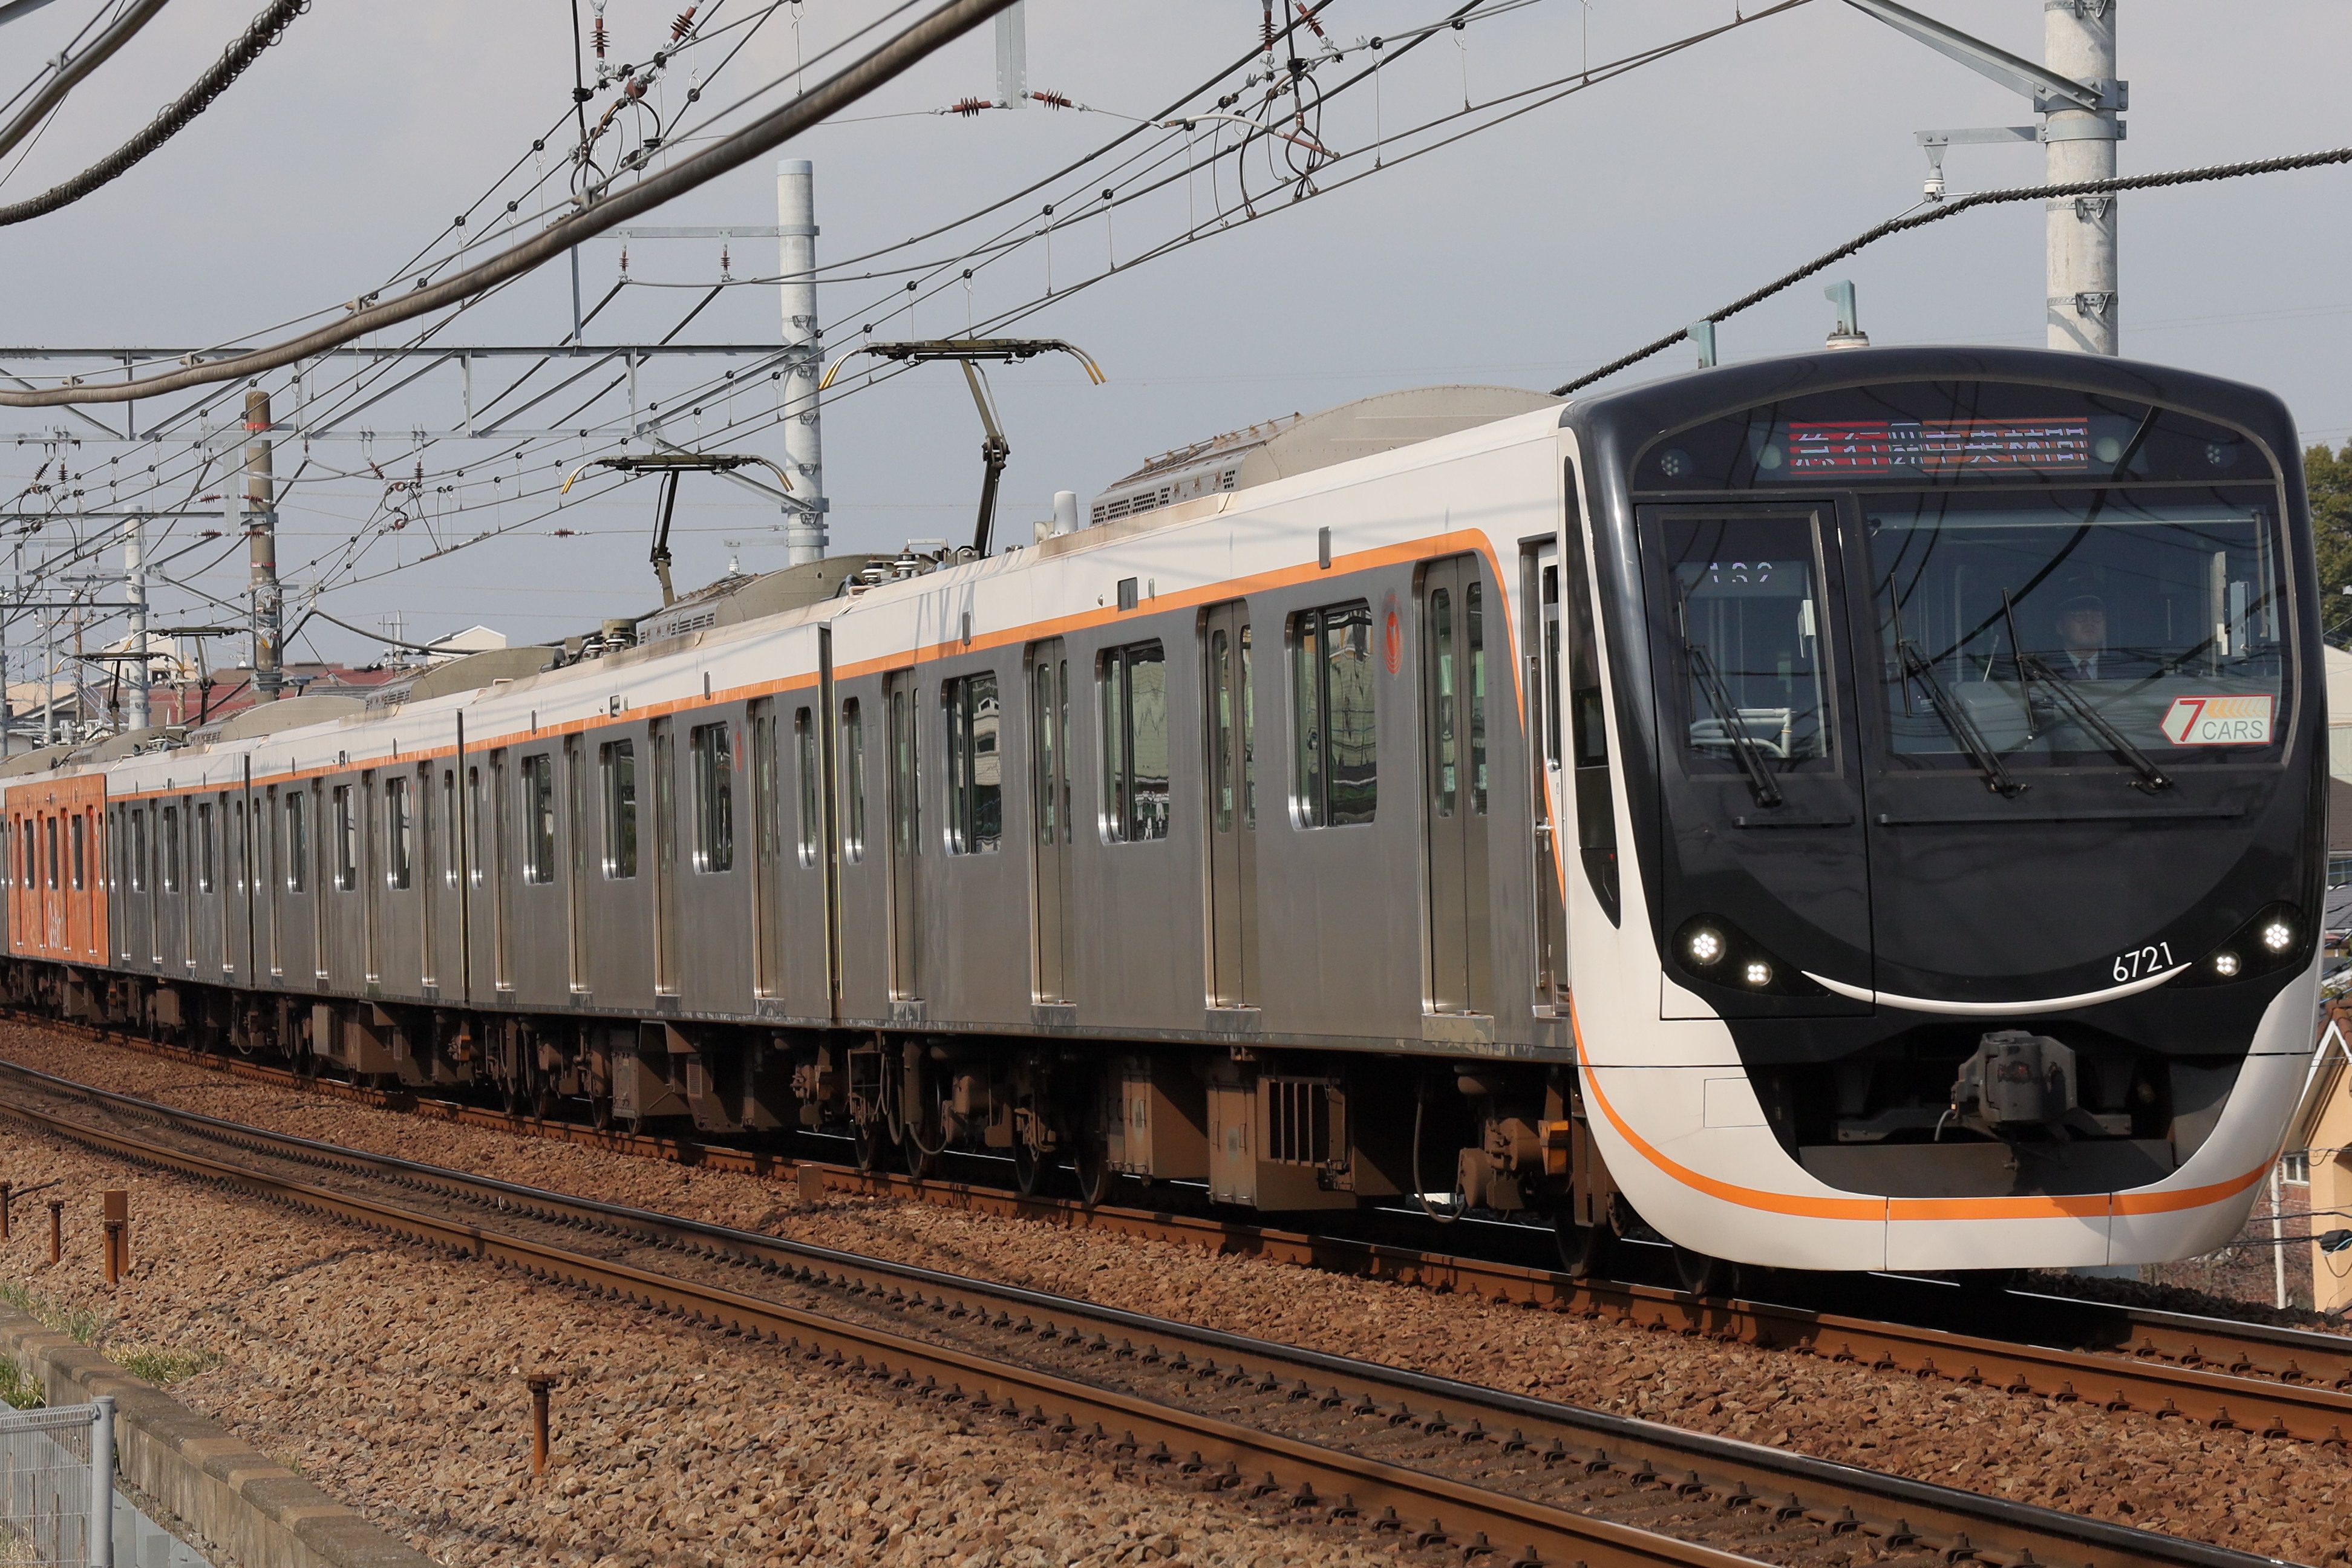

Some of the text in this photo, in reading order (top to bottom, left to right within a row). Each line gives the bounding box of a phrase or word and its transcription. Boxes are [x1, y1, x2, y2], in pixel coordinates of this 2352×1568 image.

[2180, 699, 2207, 742] 7
[2202, 720, 2264, 740] CARS
[2112, 941, 2174, 982] 6721
